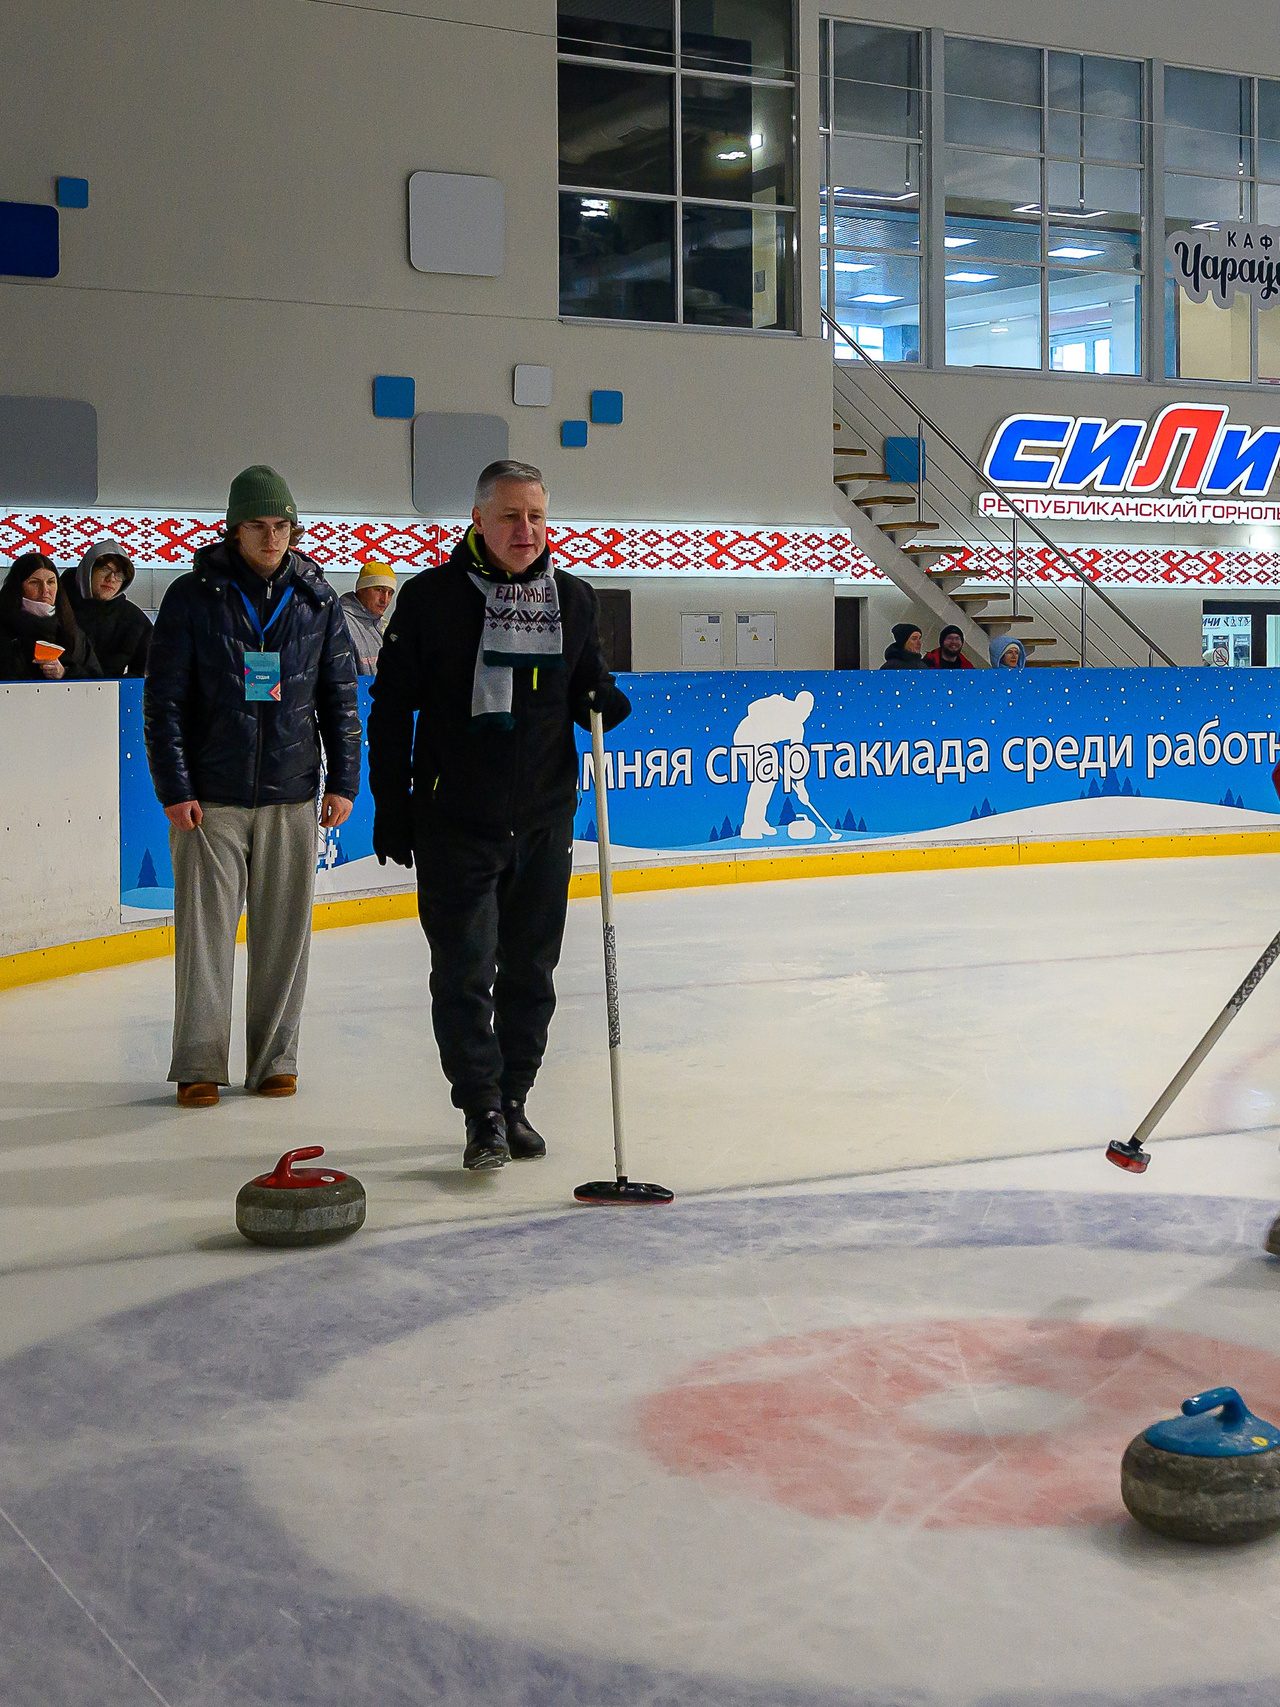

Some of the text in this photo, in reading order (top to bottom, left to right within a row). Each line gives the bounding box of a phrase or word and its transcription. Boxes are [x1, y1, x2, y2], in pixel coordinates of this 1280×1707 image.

[982, 496, 1198, 520] РЕСПУБЛИКАНСКИЙ
[576, 748, 693, 791] мняя
[705, 736, 990, 793] спартакиада
[1001, 733, 1134, 783] среди
